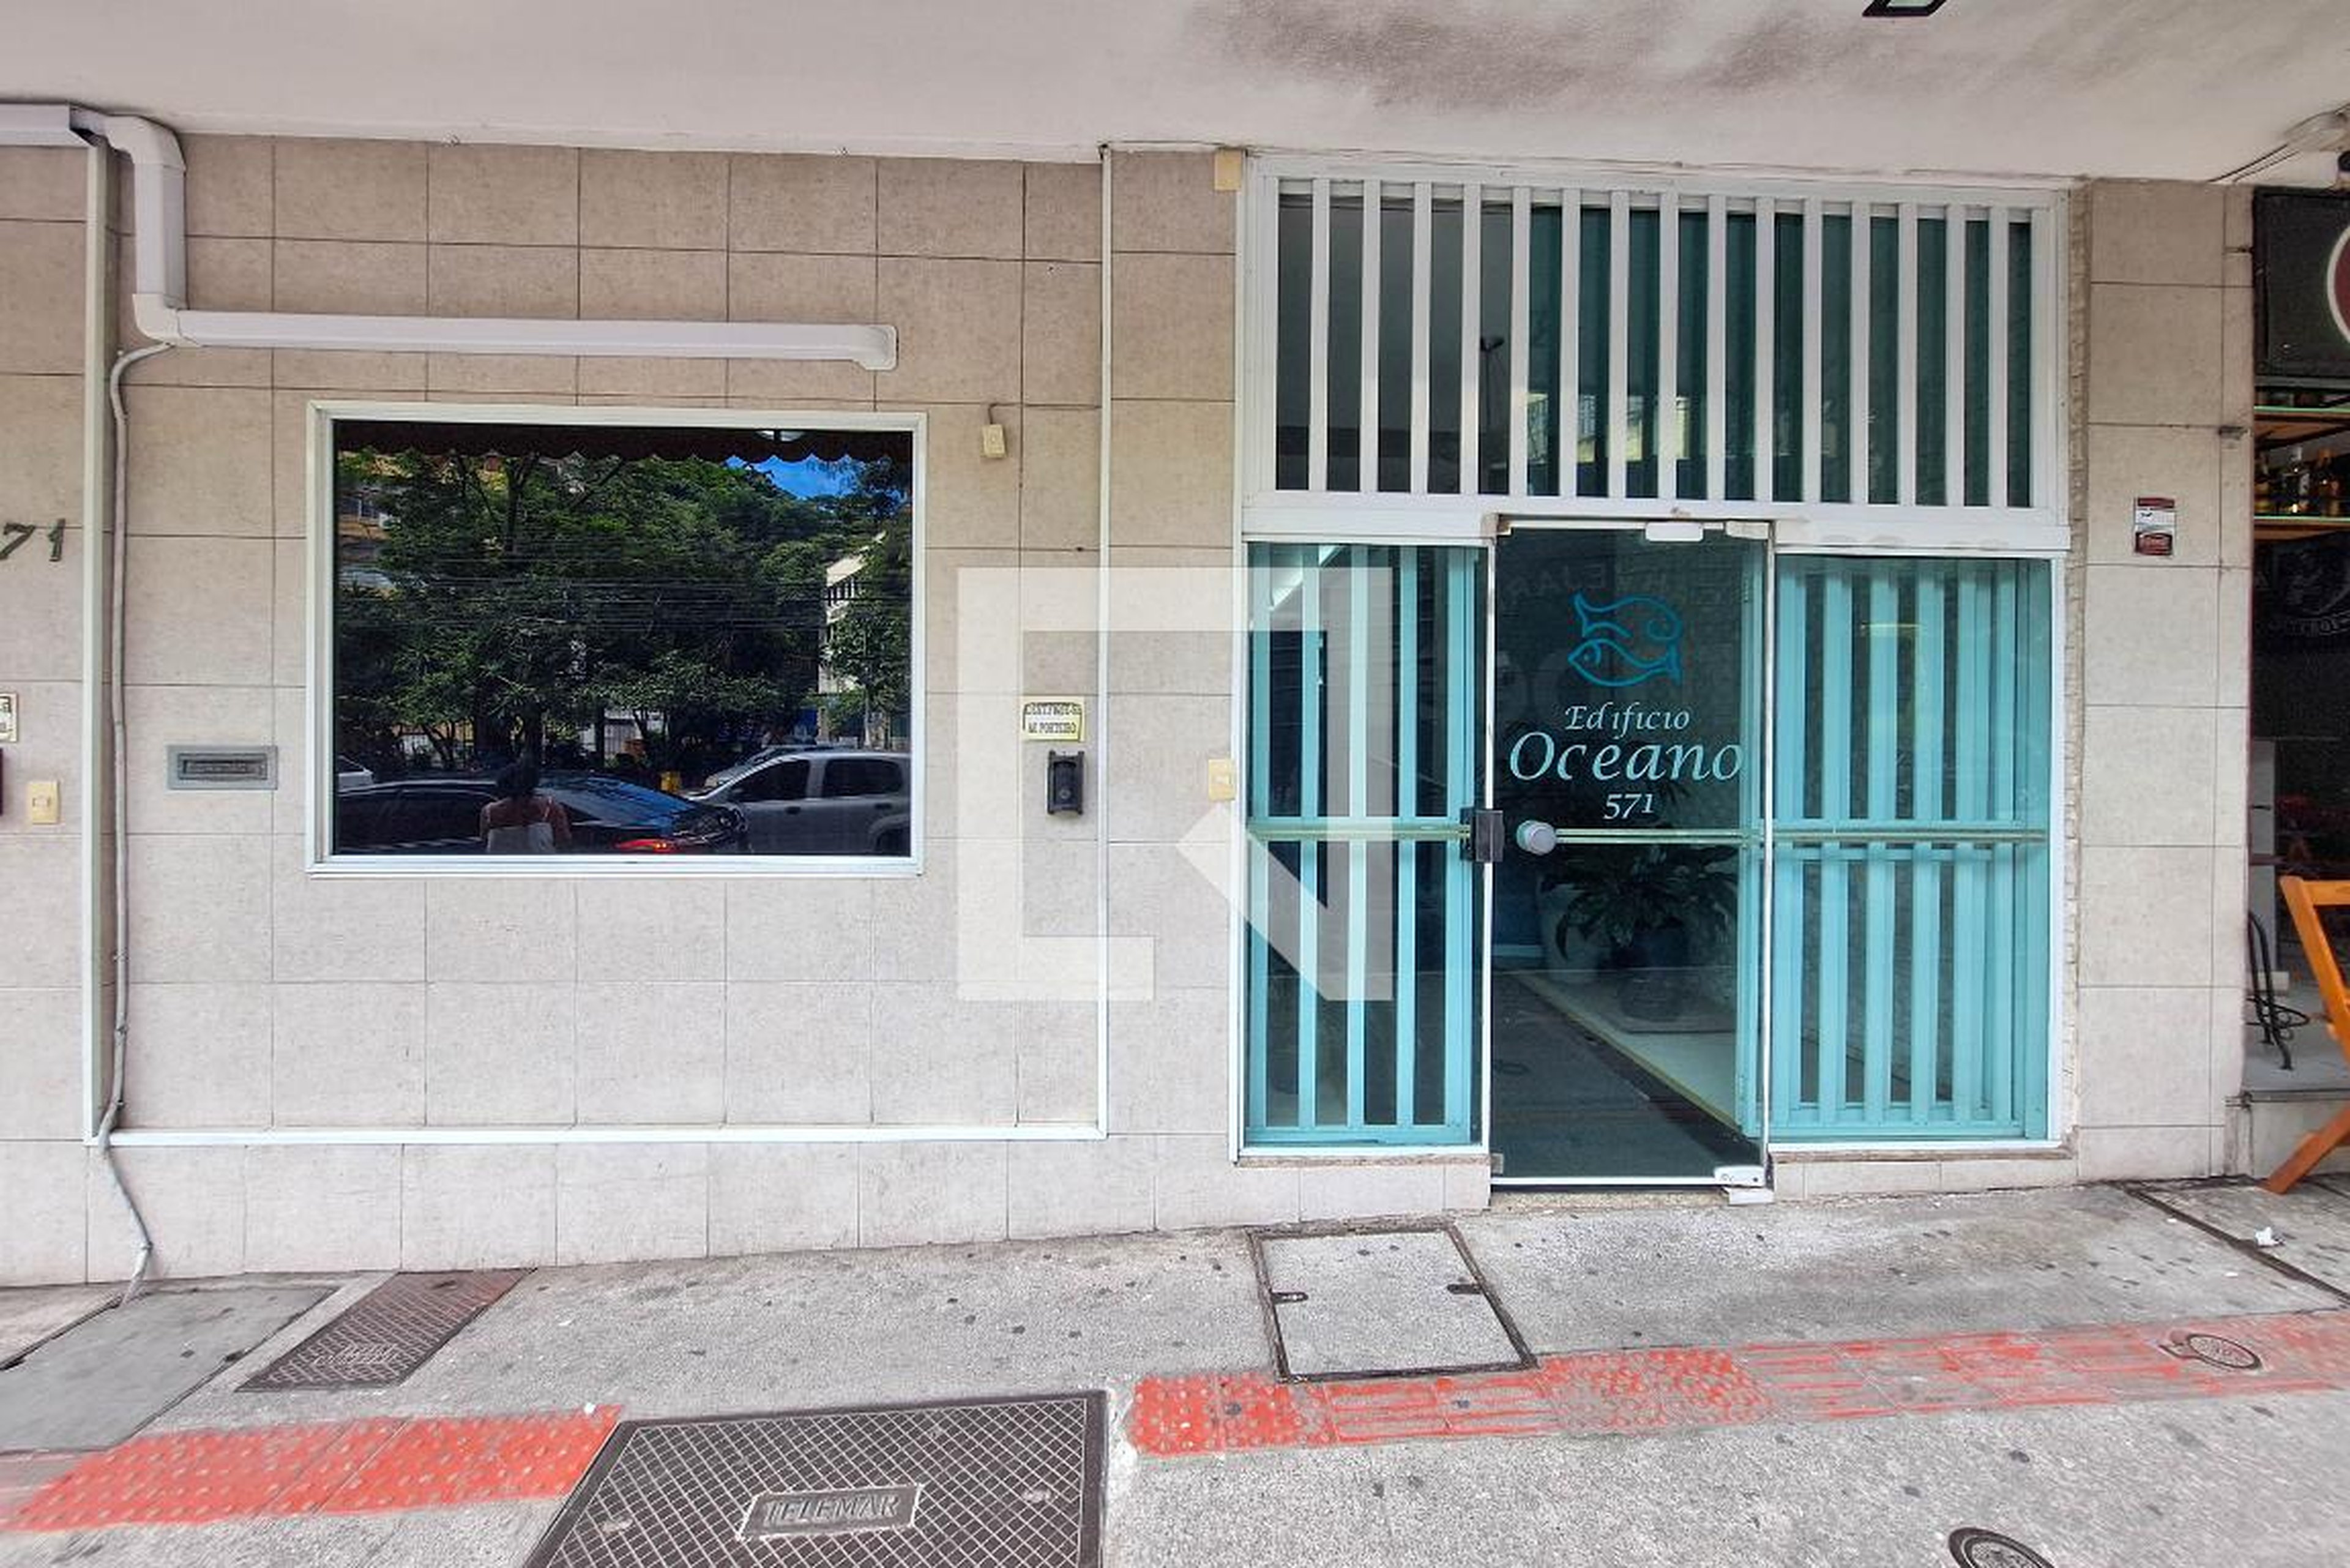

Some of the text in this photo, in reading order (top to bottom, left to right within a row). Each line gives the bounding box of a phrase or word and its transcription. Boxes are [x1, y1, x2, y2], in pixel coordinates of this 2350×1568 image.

[1565, 701, 1690, 739] Edificio
[1510, 731, 1743, 780] Oceano
[1603, 794, 1654, 820] 571
[763, 1493, 901, 1525] TELEMAR
